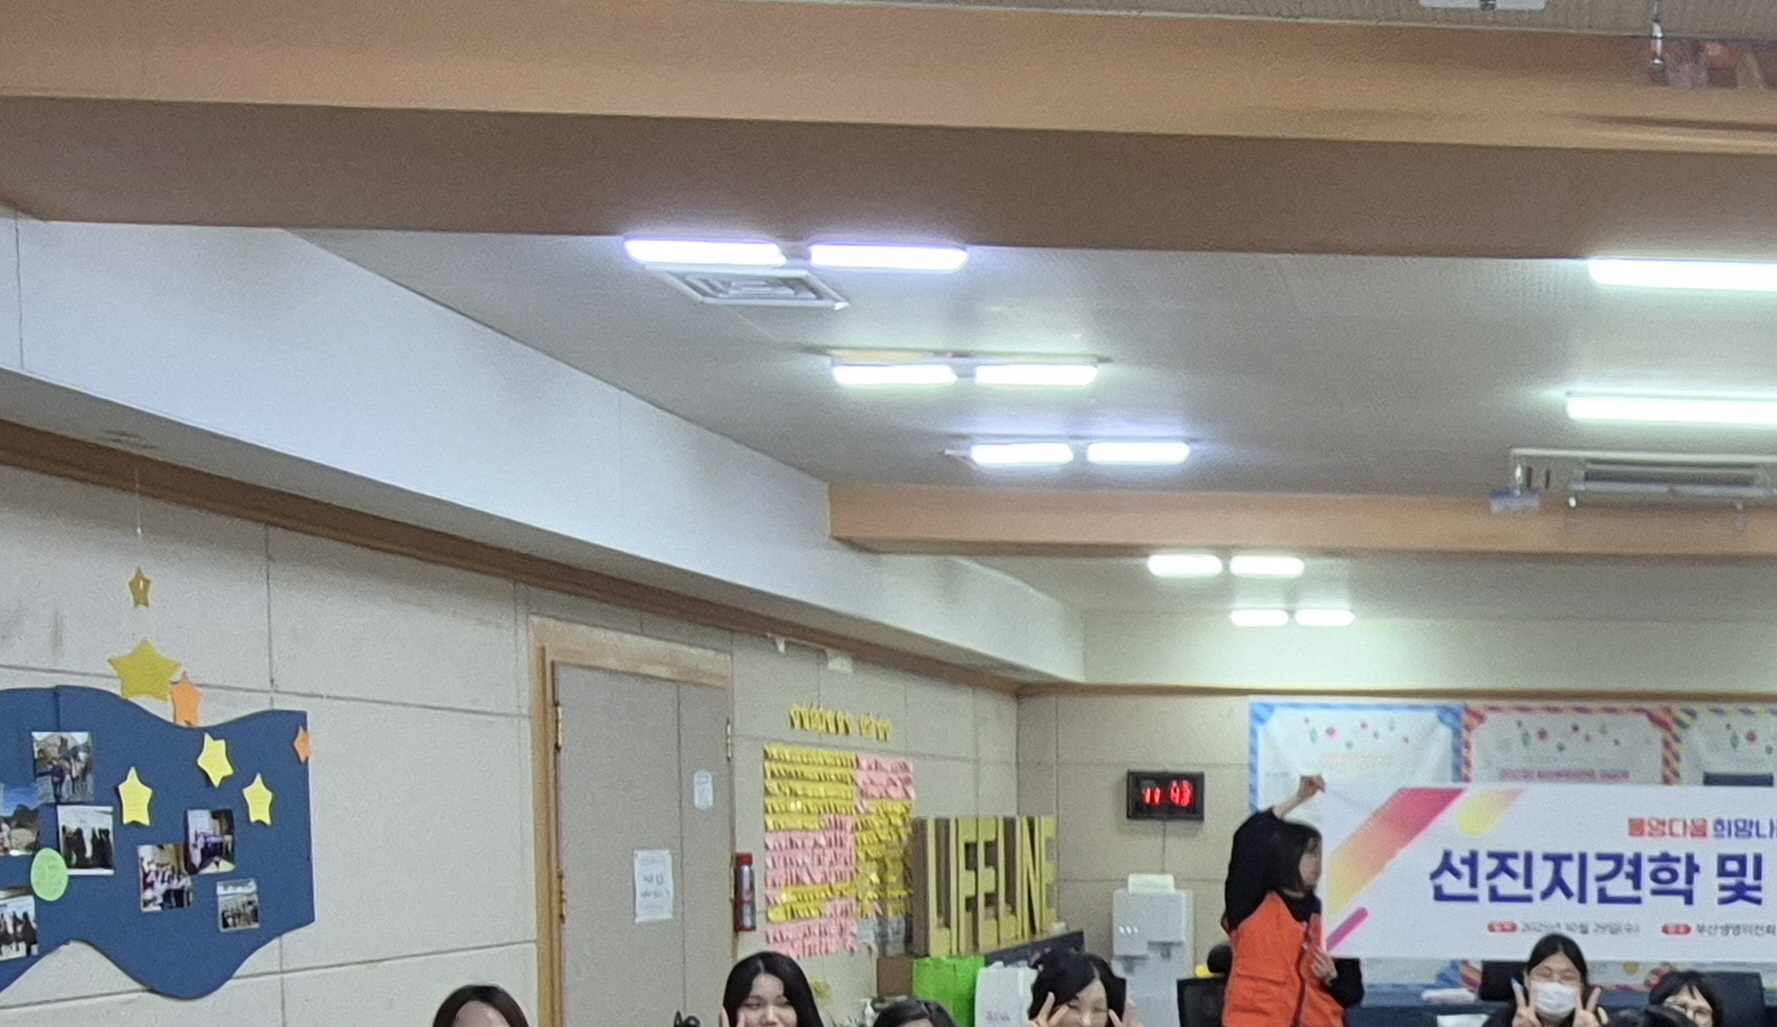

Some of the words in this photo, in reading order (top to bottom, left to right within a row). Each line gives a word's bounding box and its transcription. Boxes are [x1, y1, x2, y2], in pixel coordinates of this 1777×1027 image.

[927, 816, 1057, 957] LIFELINE
[1428, 849, 1700, 907] 선진지견학
[1715, 851, 1765, 907] 및
